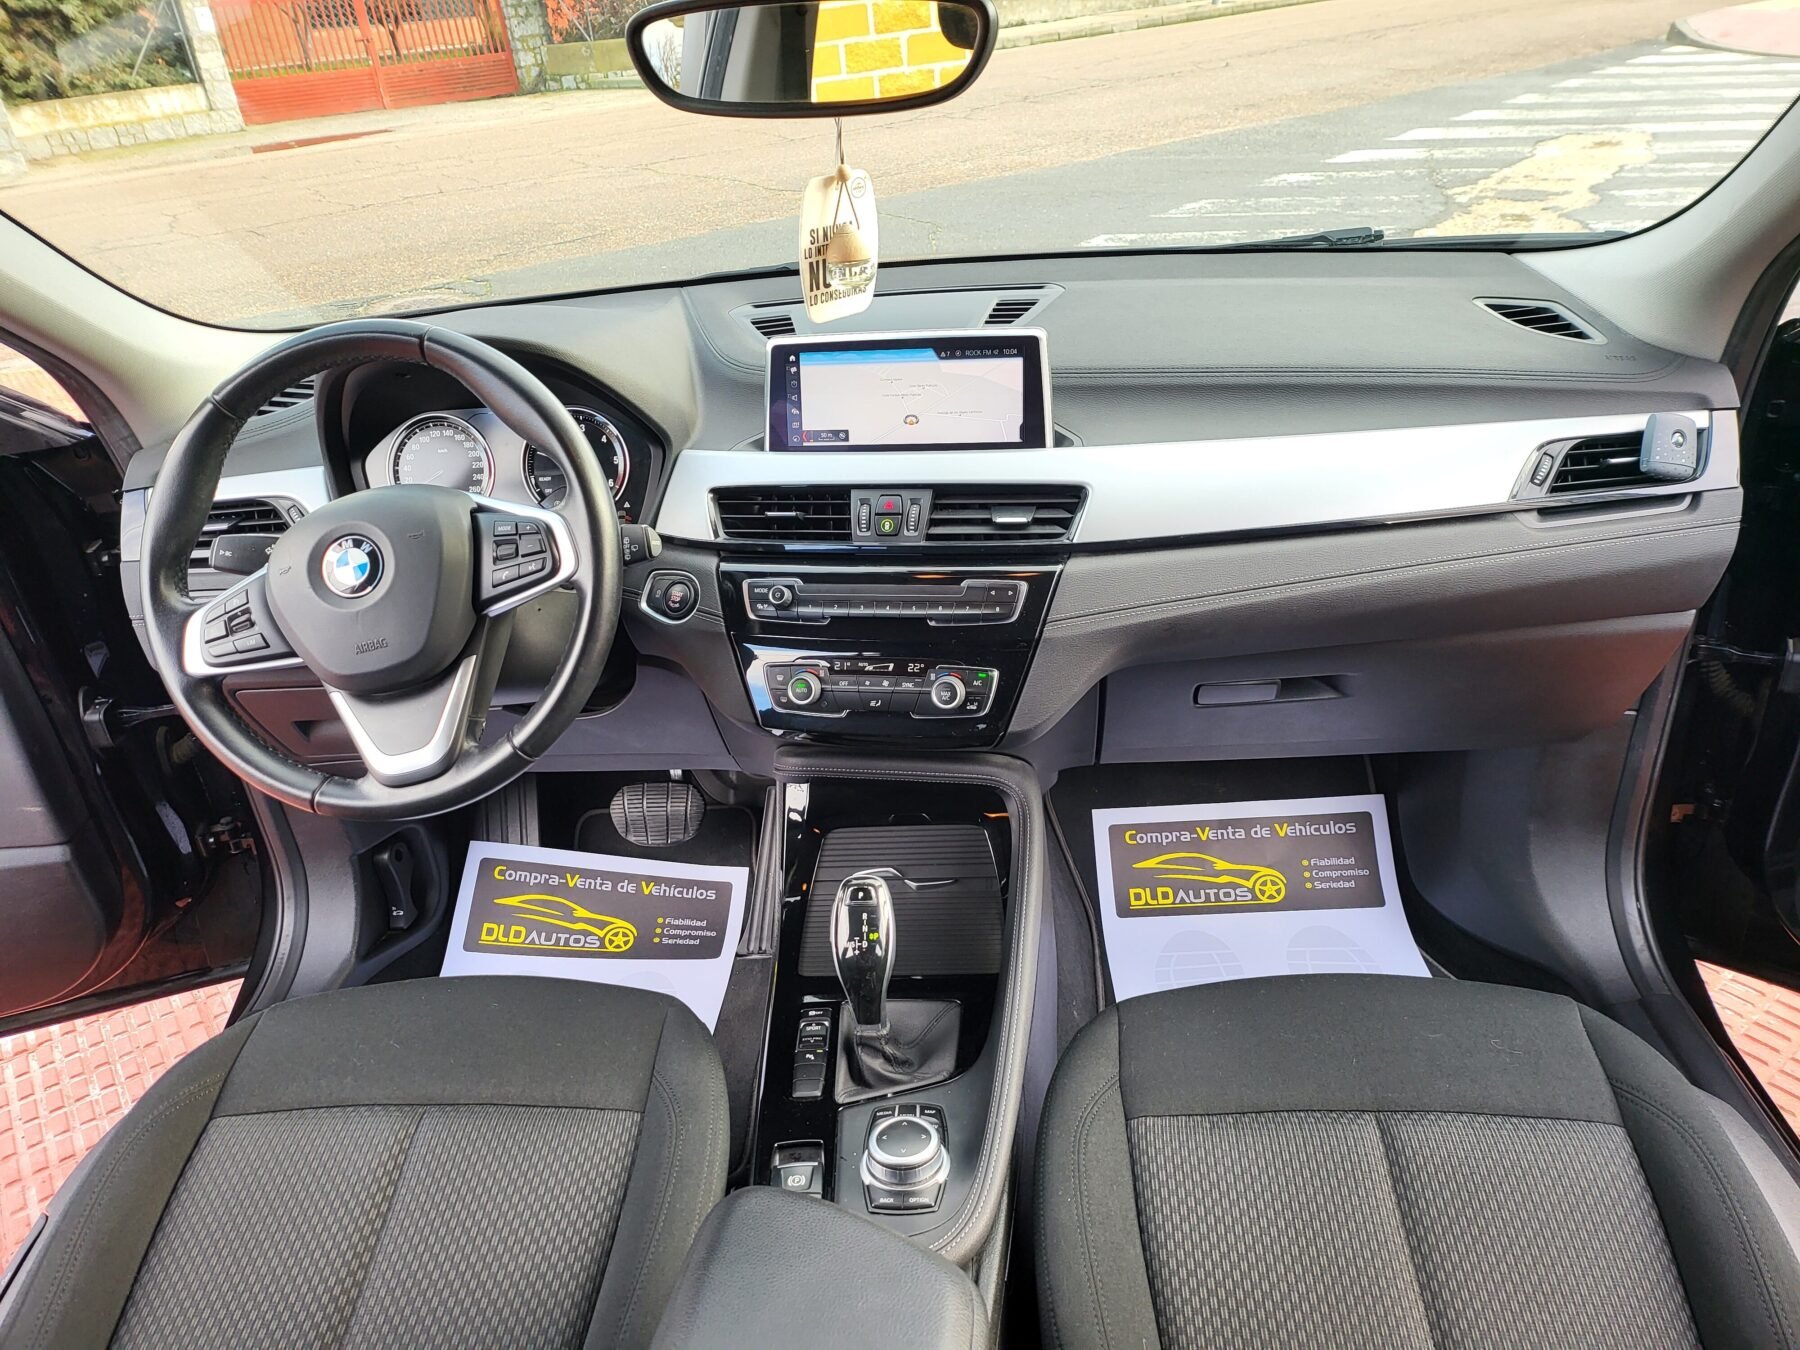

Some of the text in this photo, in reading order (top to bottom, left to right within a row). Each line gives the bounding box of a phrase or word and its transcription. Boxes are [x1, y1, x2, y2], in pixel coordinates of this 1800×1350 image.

[810, 228, 820, 245] SI
[804, 248, 812, 260] LO
[810, 295, 818, 306] LO
[601, 435, 607, 443] 4
[613, 456, 619, 464] 5
[608, 479, 614, 487] 6
[354, 637, 388, 655] AIRBAG
[908, 664, 924, 672] 22°
[1124, 820, 1356, 846] Compra-Venta de Vehículos
[1311, 857, 1355, 866] Fiabilidad
[1312, 868, 1370, 878] Compromiso
[494, 866, 717, 900] Compra-Venta de Vehículos
[1314, 879, 1355, 889] Seriedad
[665, 917, 707, 927] Fiabilidad
[663, 927, 717, 937] Compromiso
[661, 937, 700, 945] Seriedad
